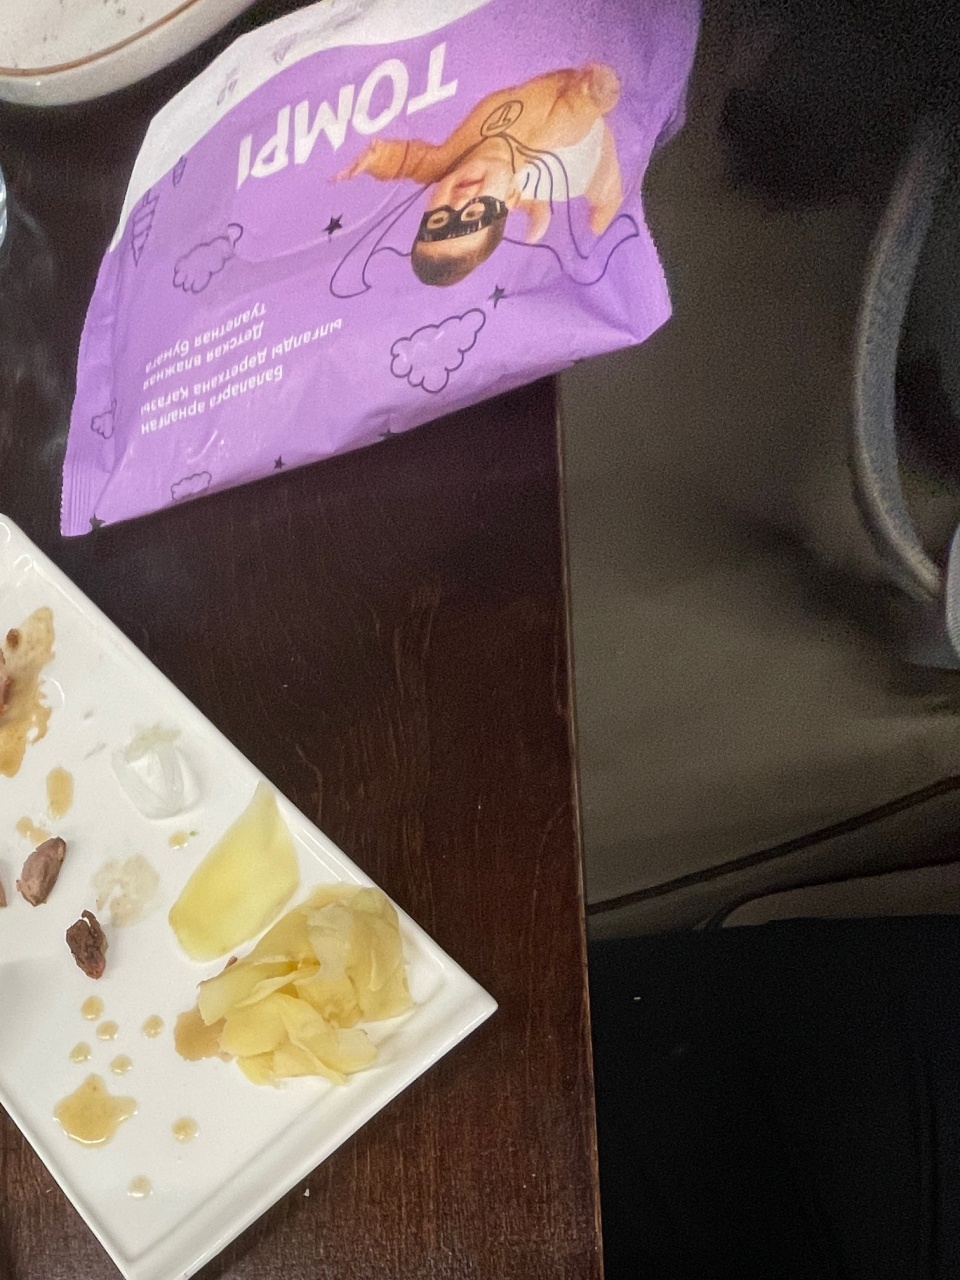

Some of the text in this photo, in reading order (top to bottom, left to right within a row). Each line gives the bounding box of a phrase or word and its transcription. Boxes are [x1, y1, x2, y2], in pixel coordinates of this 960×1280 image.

[237, 42, 458, 189] TOMPI
[143, 320, 264, 390] Детская влажная
[145, 302, 267, 373] туалетная бумага
